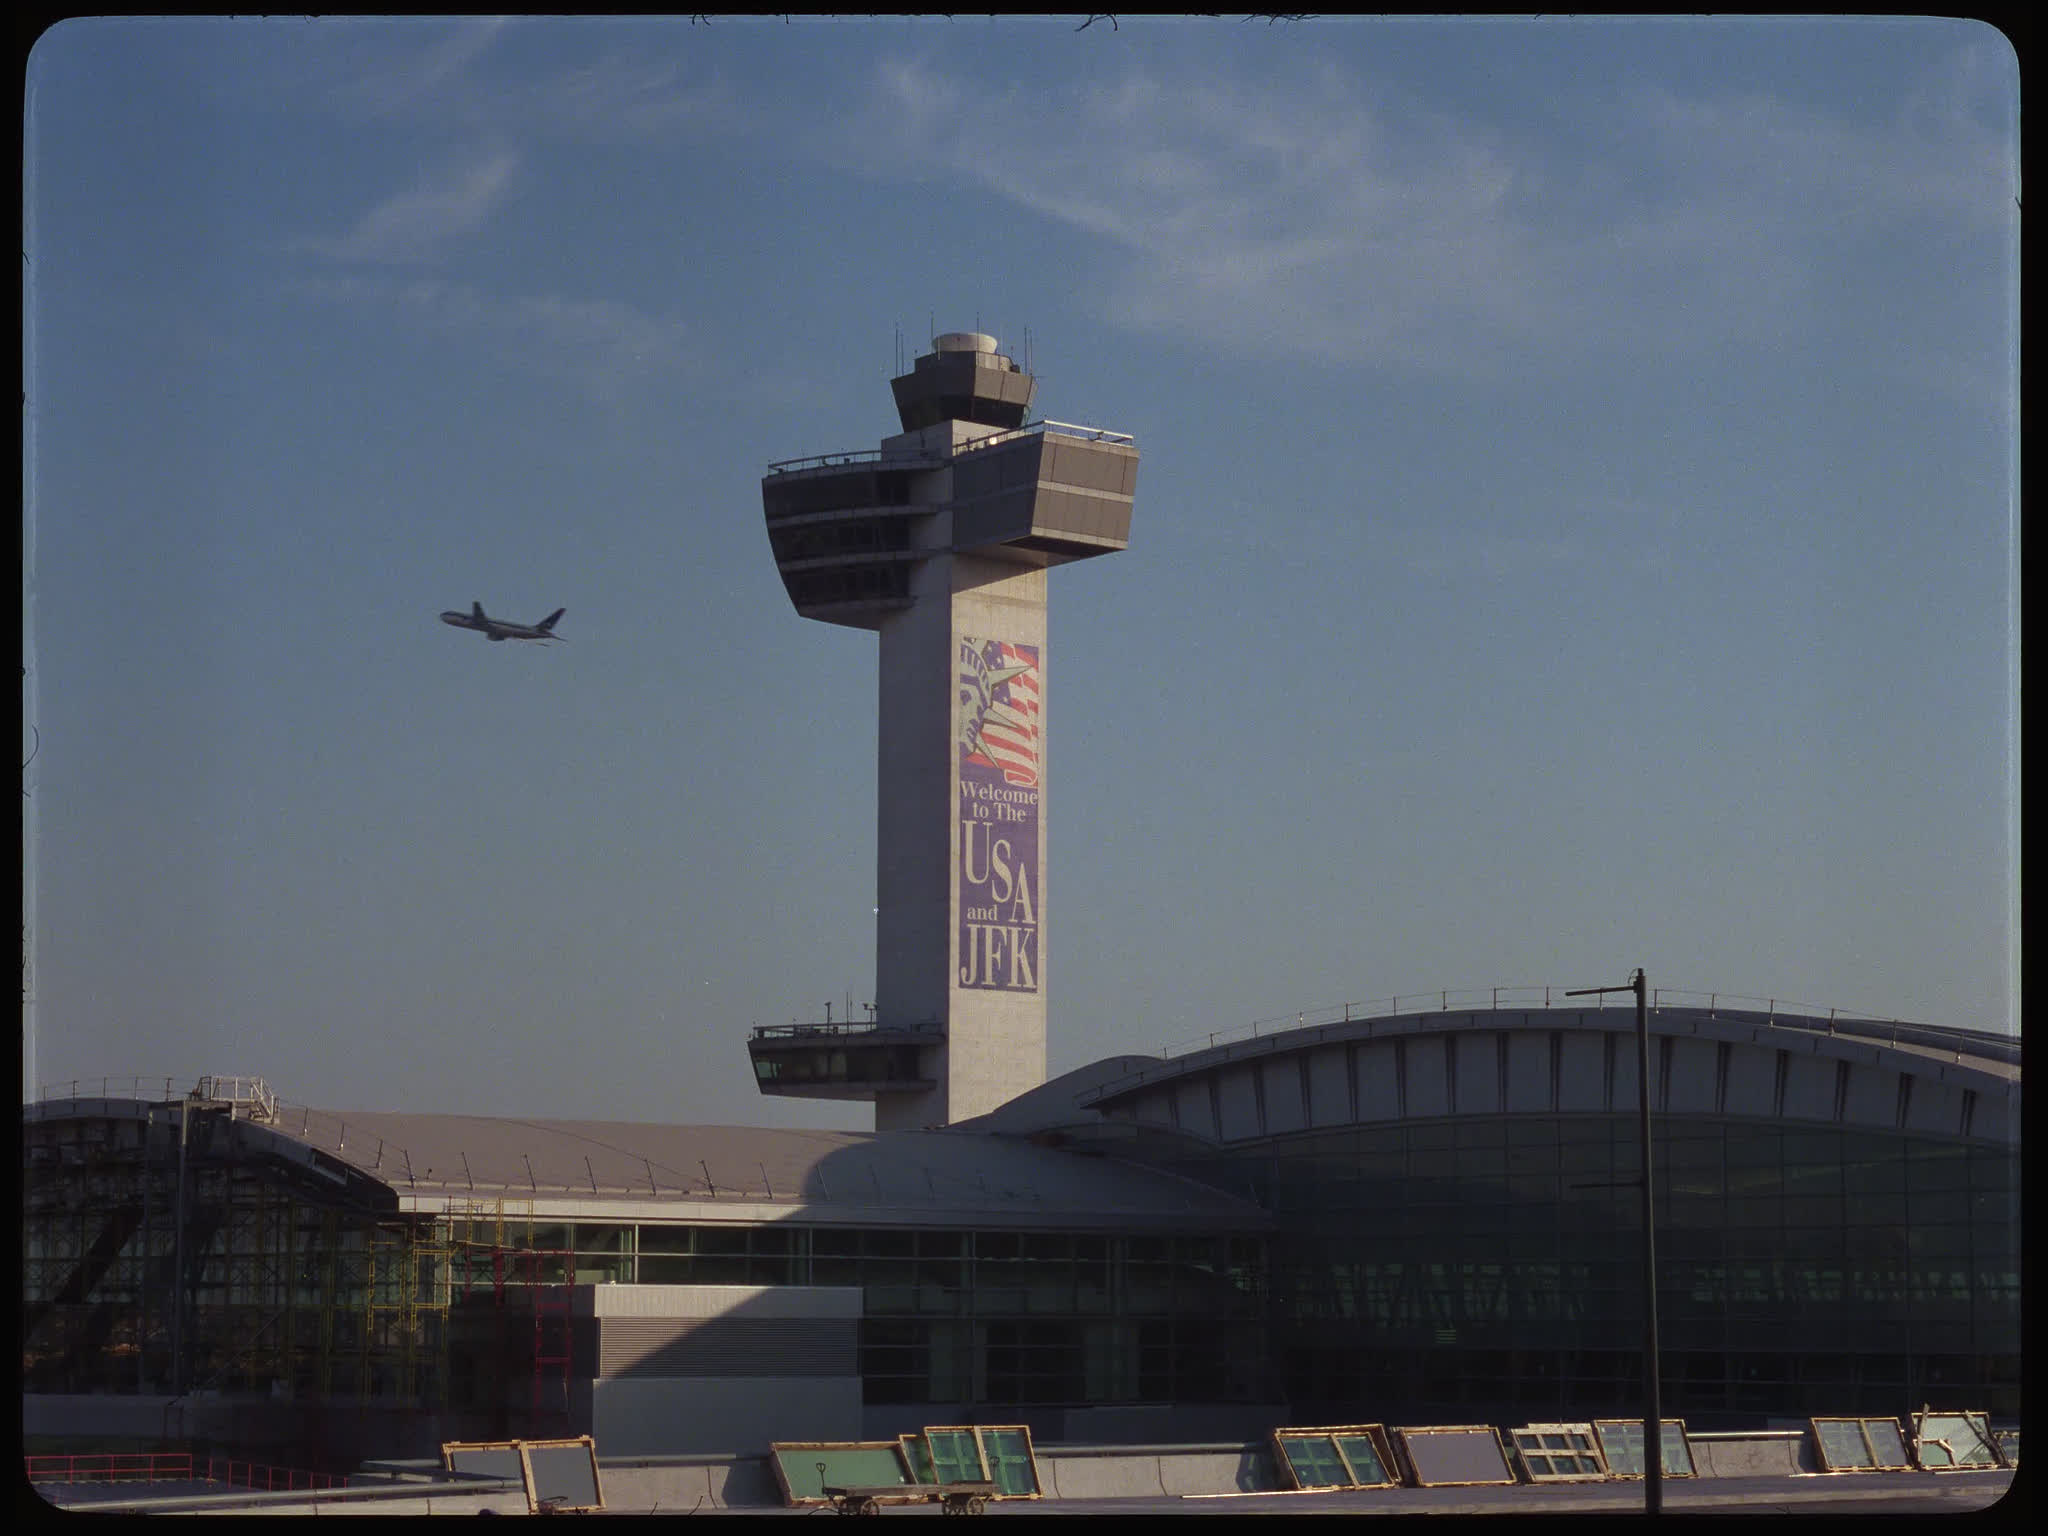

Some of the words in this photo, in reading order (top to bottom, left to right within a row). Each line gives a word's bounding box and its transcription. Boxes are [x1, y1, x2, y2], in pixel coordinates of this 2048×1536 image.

[961, 781, 1038, 805] Welcome
[973, 802, 989, 818] to
[993, 802, 1026, 822] The
[962, 820, 1037, 924] USA
[967, 904, 997, 921] and
[960, 924, 1037, 988] JFK
